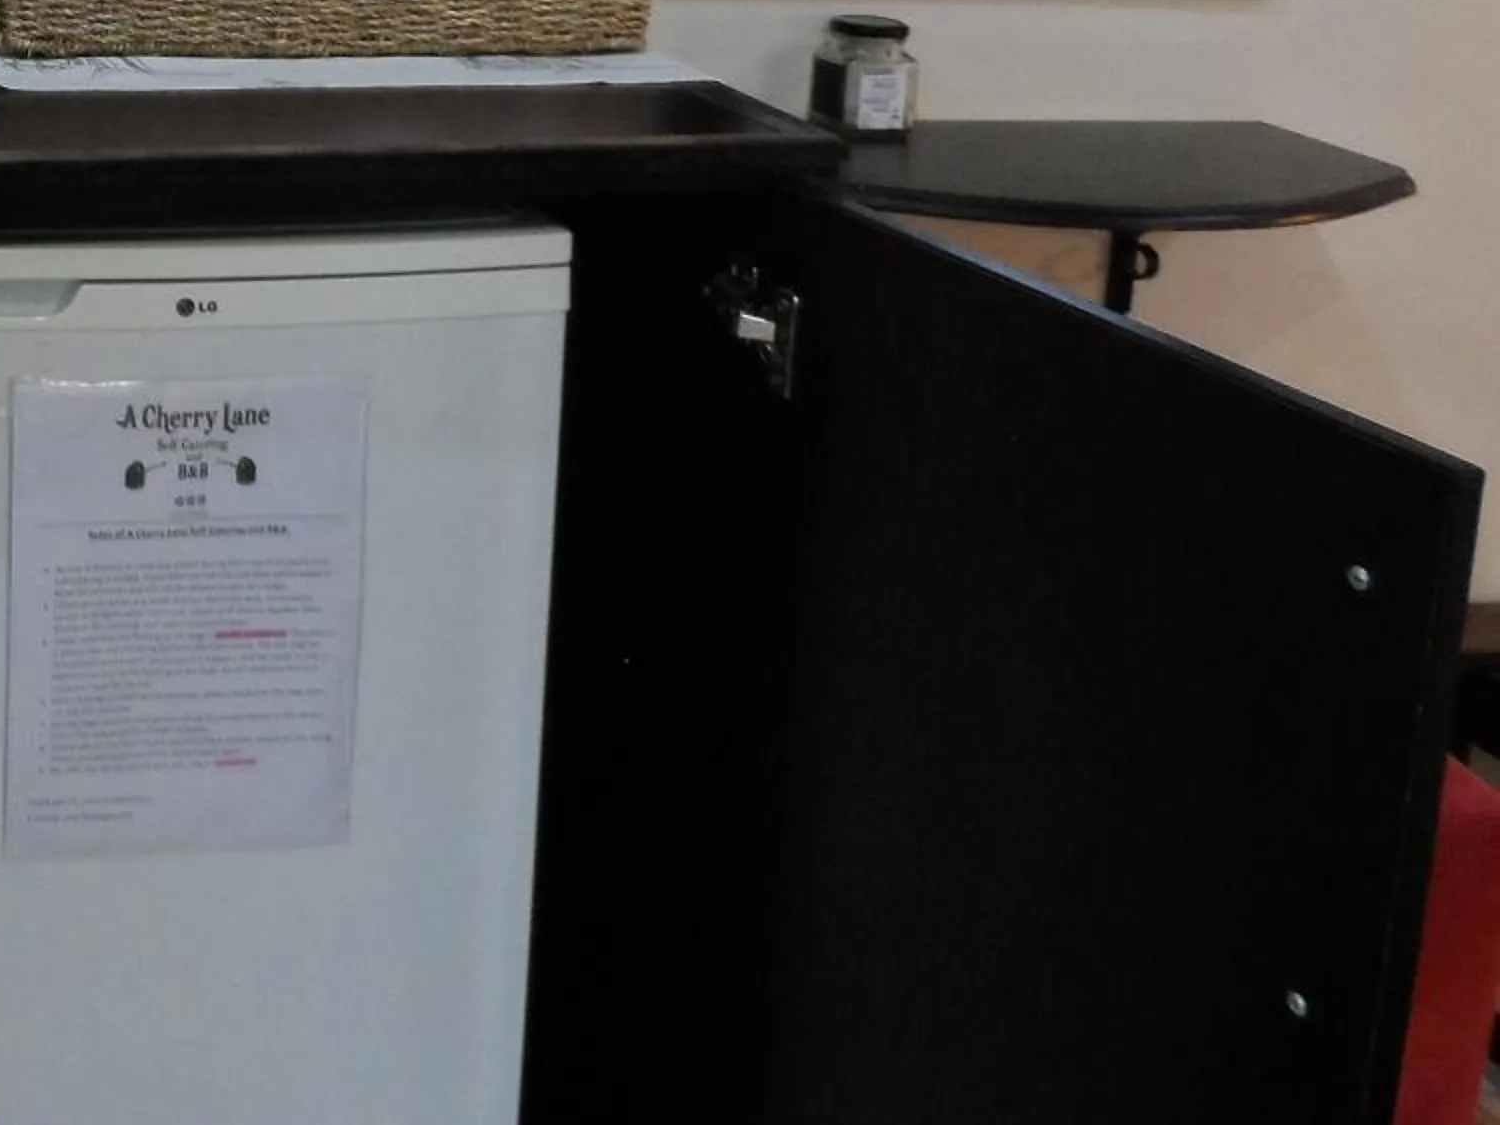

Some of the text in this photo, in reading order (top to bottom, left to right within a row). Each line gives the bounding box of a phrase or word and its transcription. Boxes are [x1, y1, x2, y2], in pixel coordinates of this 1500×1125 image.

[116, 402, 271, 435] A Cherry Lane
[178, 462, 209, 480] B&B
